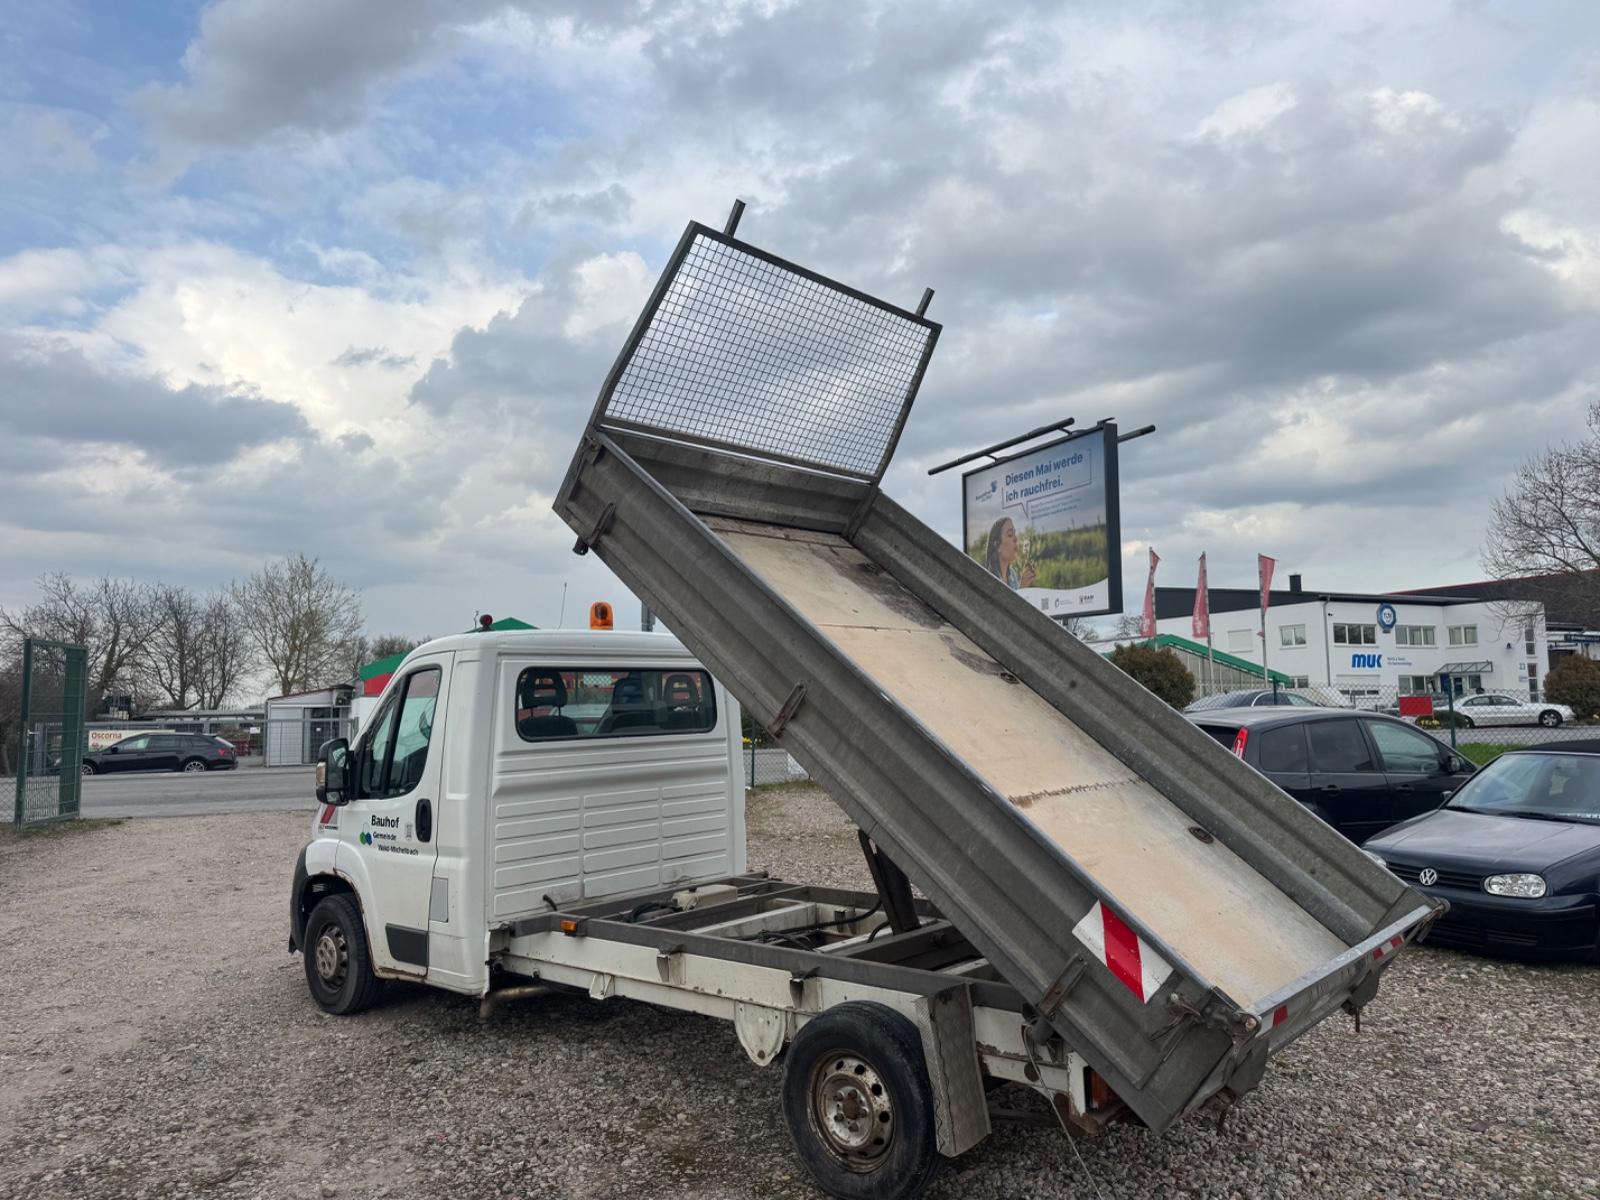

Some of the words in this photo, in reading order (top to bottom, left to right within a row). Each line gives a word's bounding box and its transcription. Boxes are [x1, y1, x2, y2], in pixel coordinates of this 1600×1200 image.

[1005, 470, 1034, 486] Diesen
[1035, 461, 1052, 477] Mai
[1053, 453, 1083, 470] werde
[1005, 489, 1019, 502] ich
[1020, 475, 1063, 498] rauchfrei.
[371, 814, 400, 829] Bauhof
[372, 831, 397, 841] Gemeinde
